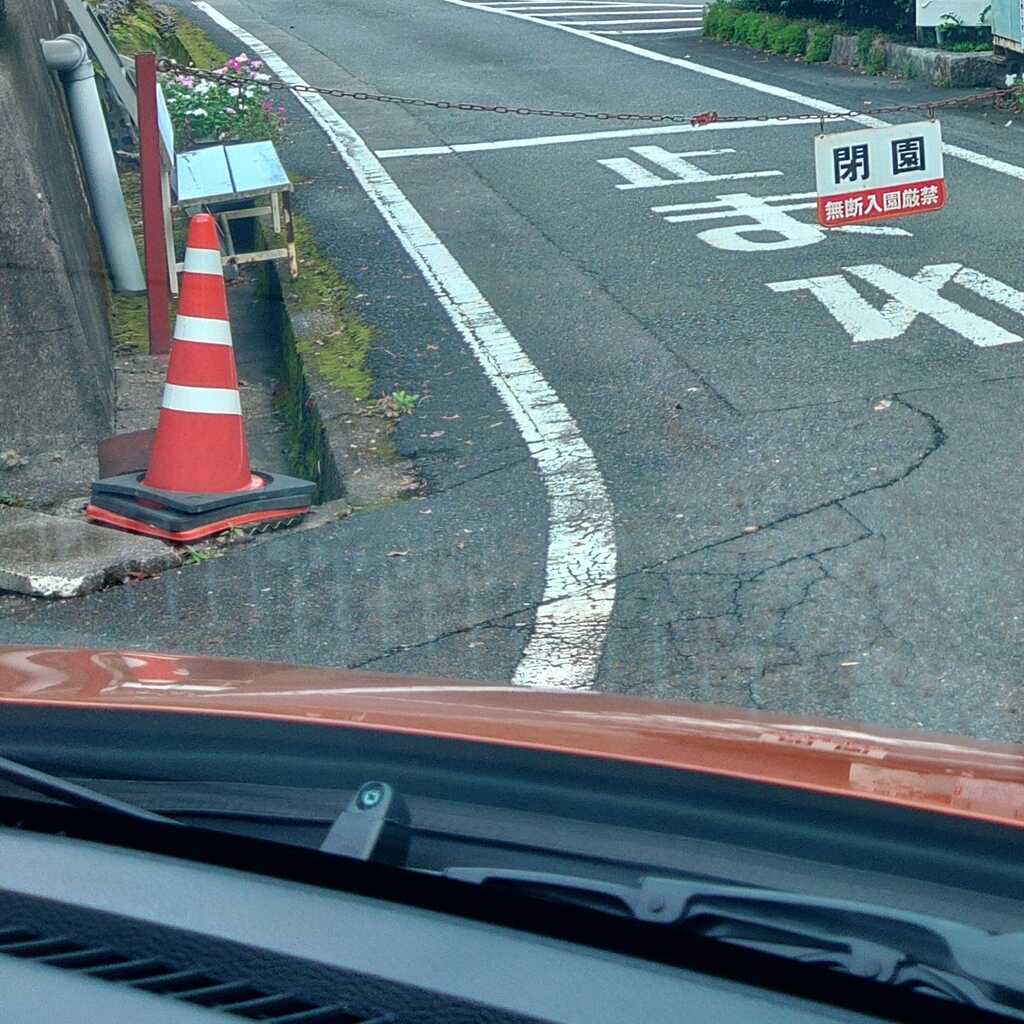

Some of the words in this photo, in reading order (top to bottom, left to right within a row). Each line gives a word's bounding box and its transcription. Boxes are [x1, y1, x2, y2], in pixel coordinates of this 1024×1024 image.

[832, 136, 927, 184] 閉園
[824, 186, 938, 221] 無断入園厳禁
